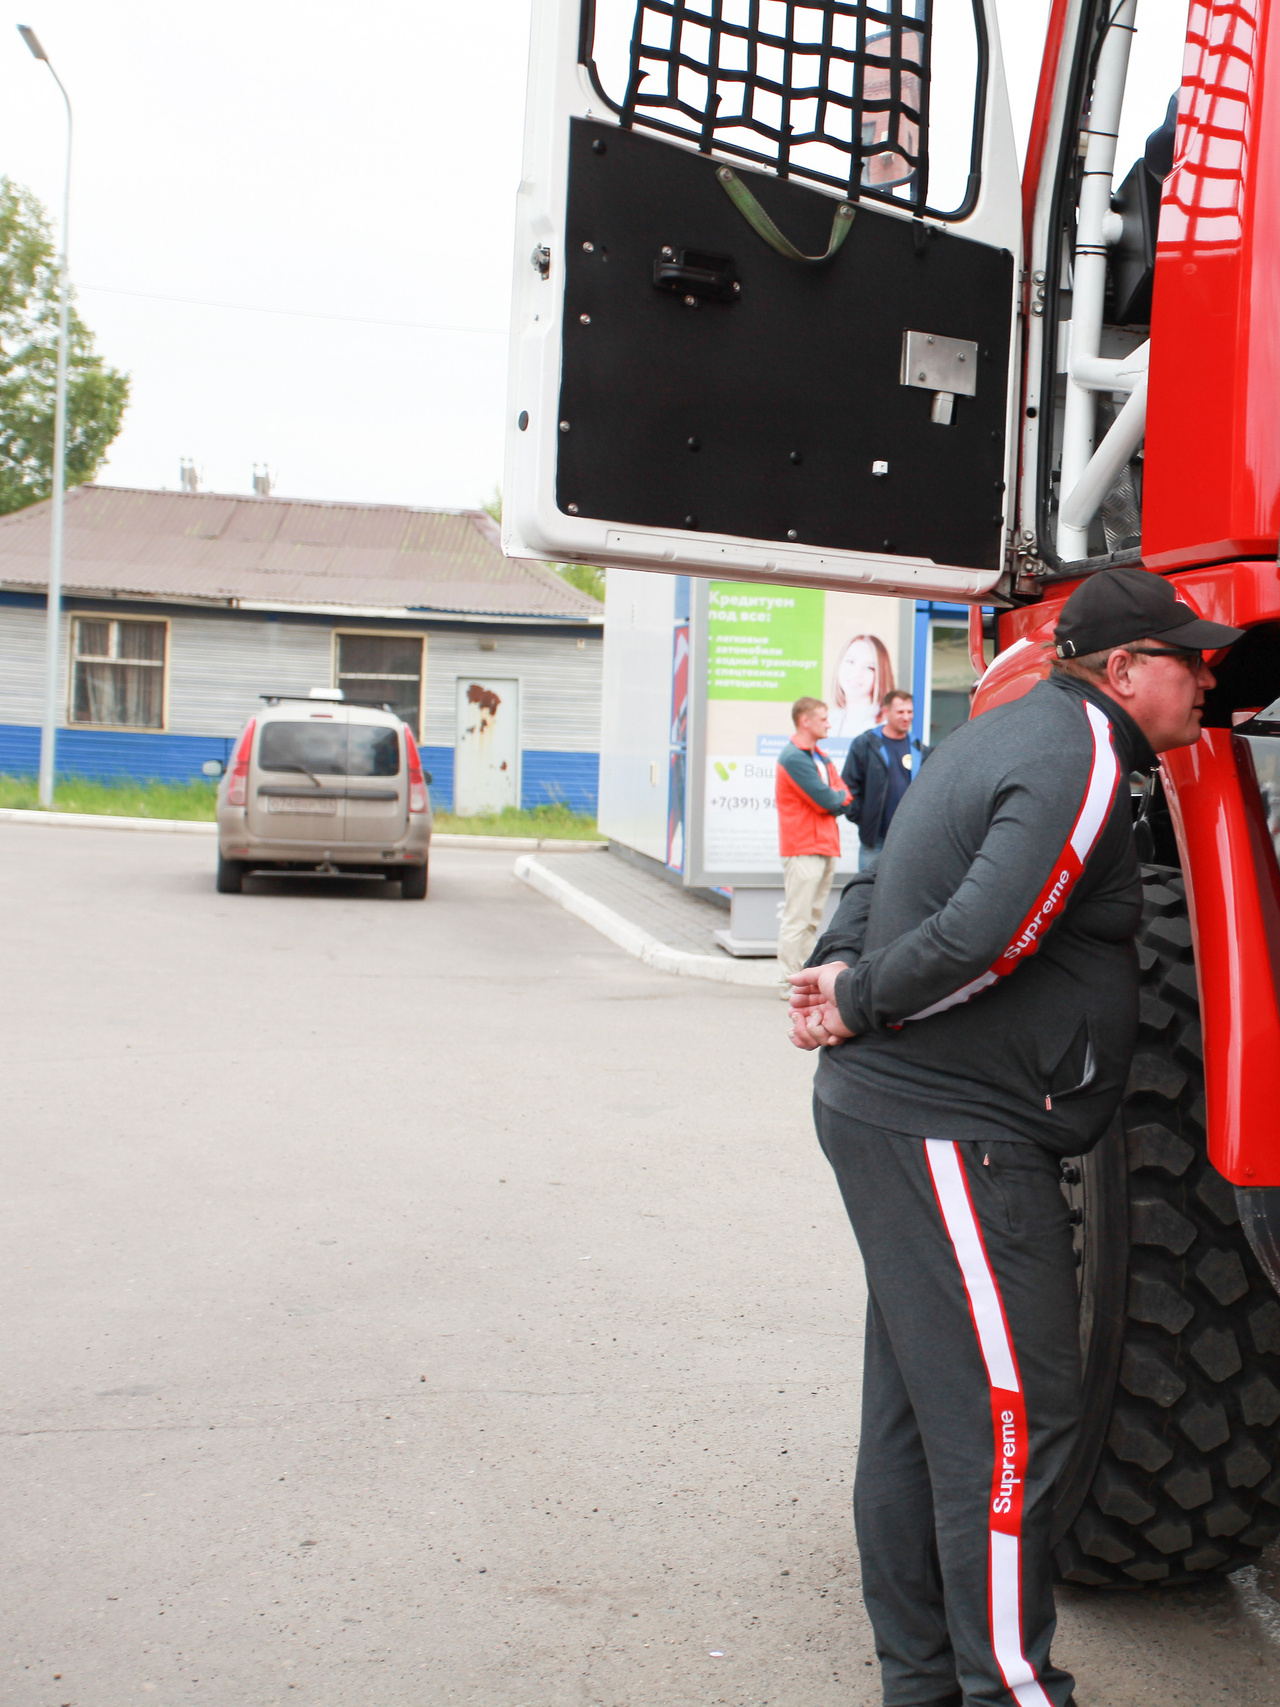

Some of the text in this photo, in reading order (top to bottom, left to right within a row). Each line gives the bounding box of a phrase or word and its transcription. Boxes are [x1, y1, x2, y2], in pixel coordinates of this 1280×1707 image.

[709, 590, 795, 610] Кредитуем
[709, 610, 772, 622] под все:
[716, 635, 769, 644] легковые
[716, 645, 783, 656] автомобили
[716, 656, 818, 670] водный транспорт
[715, 668, 787, 678] спецтехника
[715, 679, 779, 688] мотоциклы
[711, 796, 759, 812] +7(391)
[1004, 870, 1069, 959] Supreme
[993, 1410, 1021, 1513] Supreme
